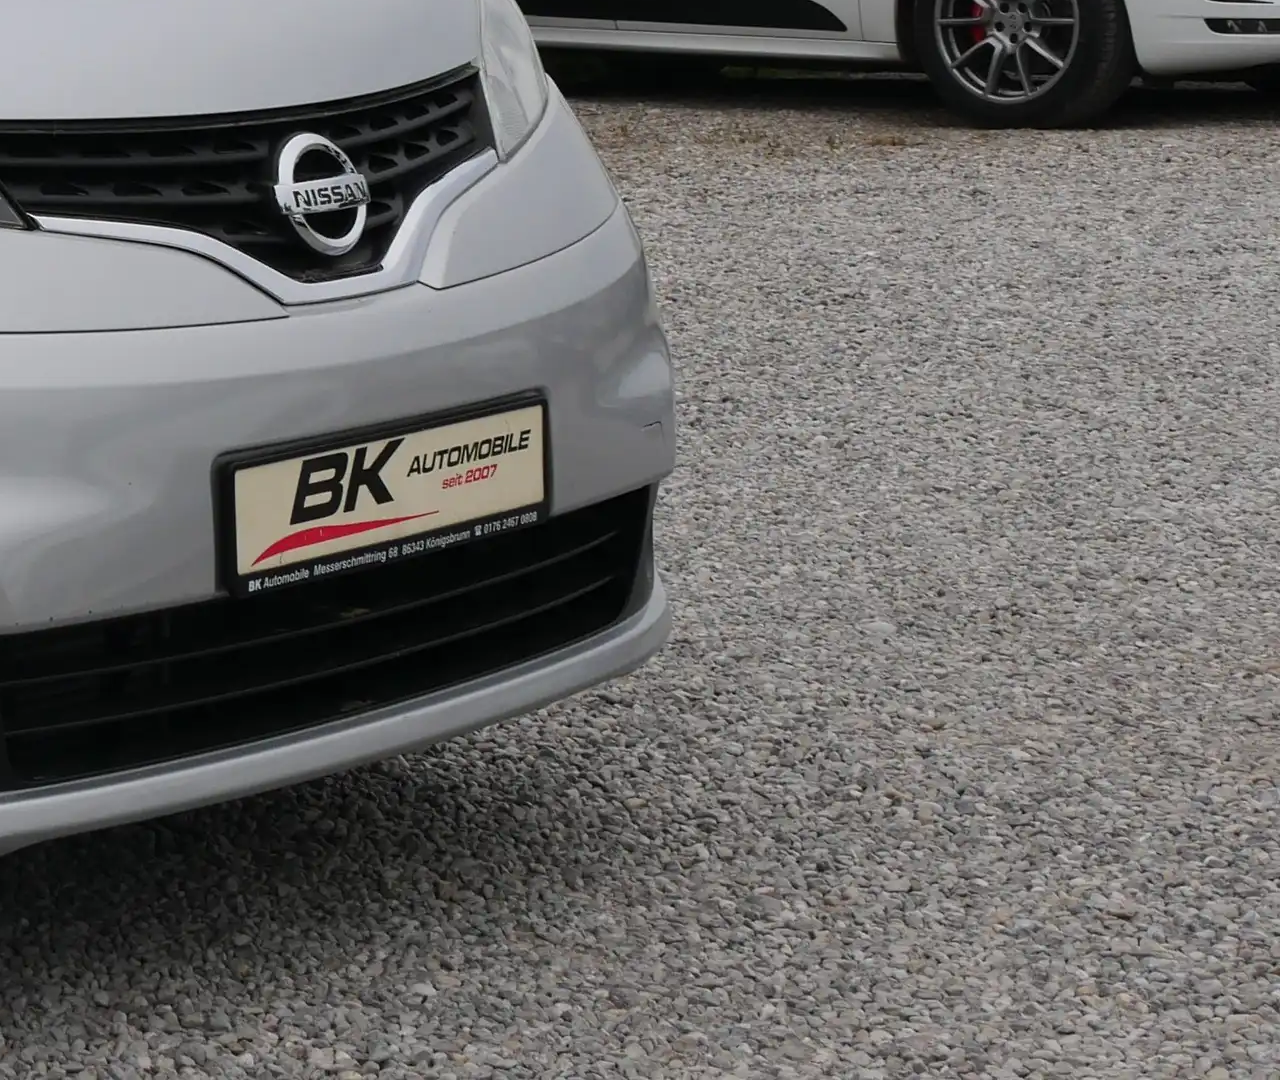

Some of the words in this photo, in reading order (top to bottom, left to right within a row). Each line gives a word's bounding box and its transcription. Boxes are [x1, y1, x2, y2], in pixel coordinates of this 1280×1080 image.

[293, 181, 367, 208] NISSAN
[289, 437, 405, 526] BK
[407, 429, 532, 477] AUTOMOBILE
[442, 472, 463, 489] seit
[464, 463, 498, 484] 2007
[248, 578, 262, 592] BK
[263, 568, 309, 588] Automobile
